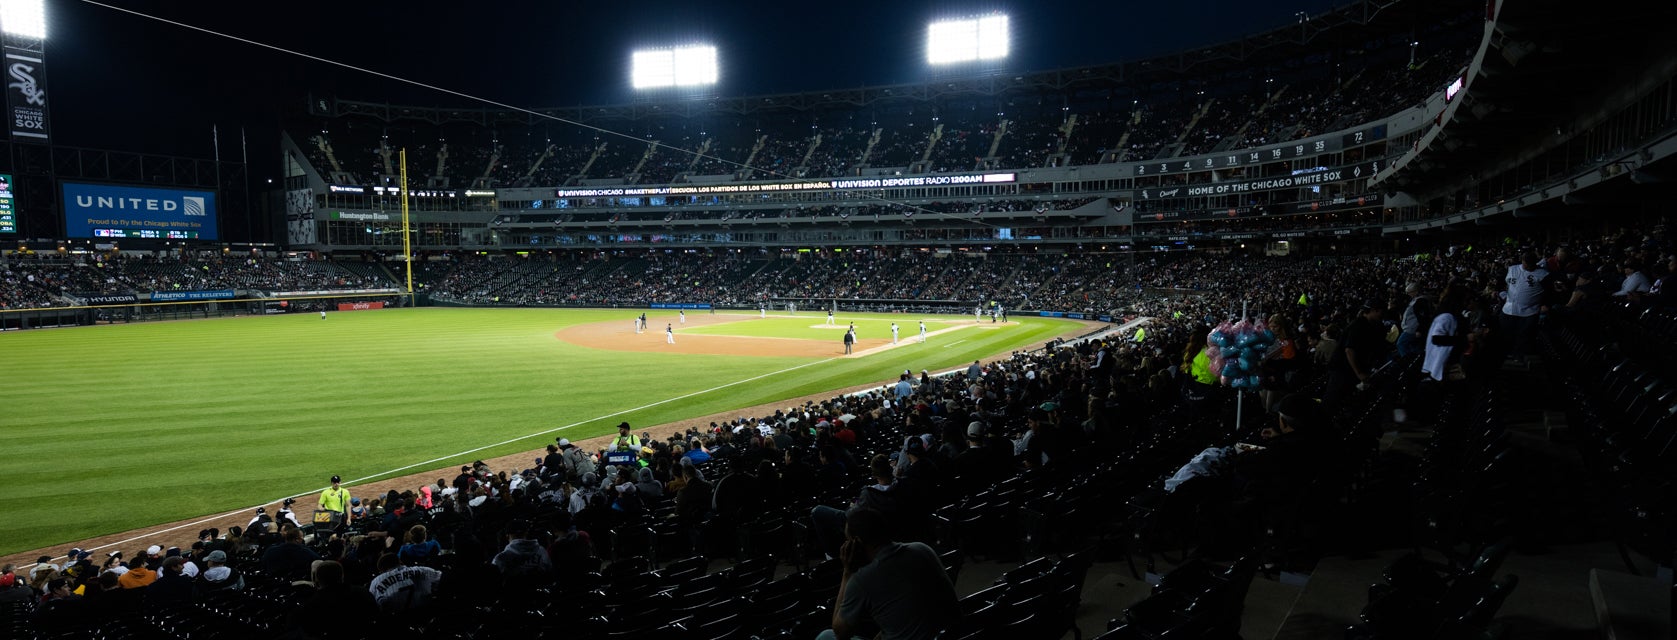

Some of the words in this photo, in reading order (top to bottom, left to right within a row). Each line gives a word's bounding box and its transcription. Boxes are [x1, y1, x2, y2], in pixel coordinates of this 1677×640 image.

[16, 120, 43, 129] SOX
[1354, 132, 1363, 141] 72
[1272, 149, 1281, 157] 16
[1315, 141, 1324, 149] 35
[1189, 186, 1213, 195] HOME
[1232, 183, 1249, 191] THE
[1251, 178, 1292, 190] CHICAGO
[1295, 174, 1321, 185] WHITE
[1323, 171, 1341, 182] SOX
[77, 195, 177, 211] UNITED
[340, 212, 373, 220] Huntington
